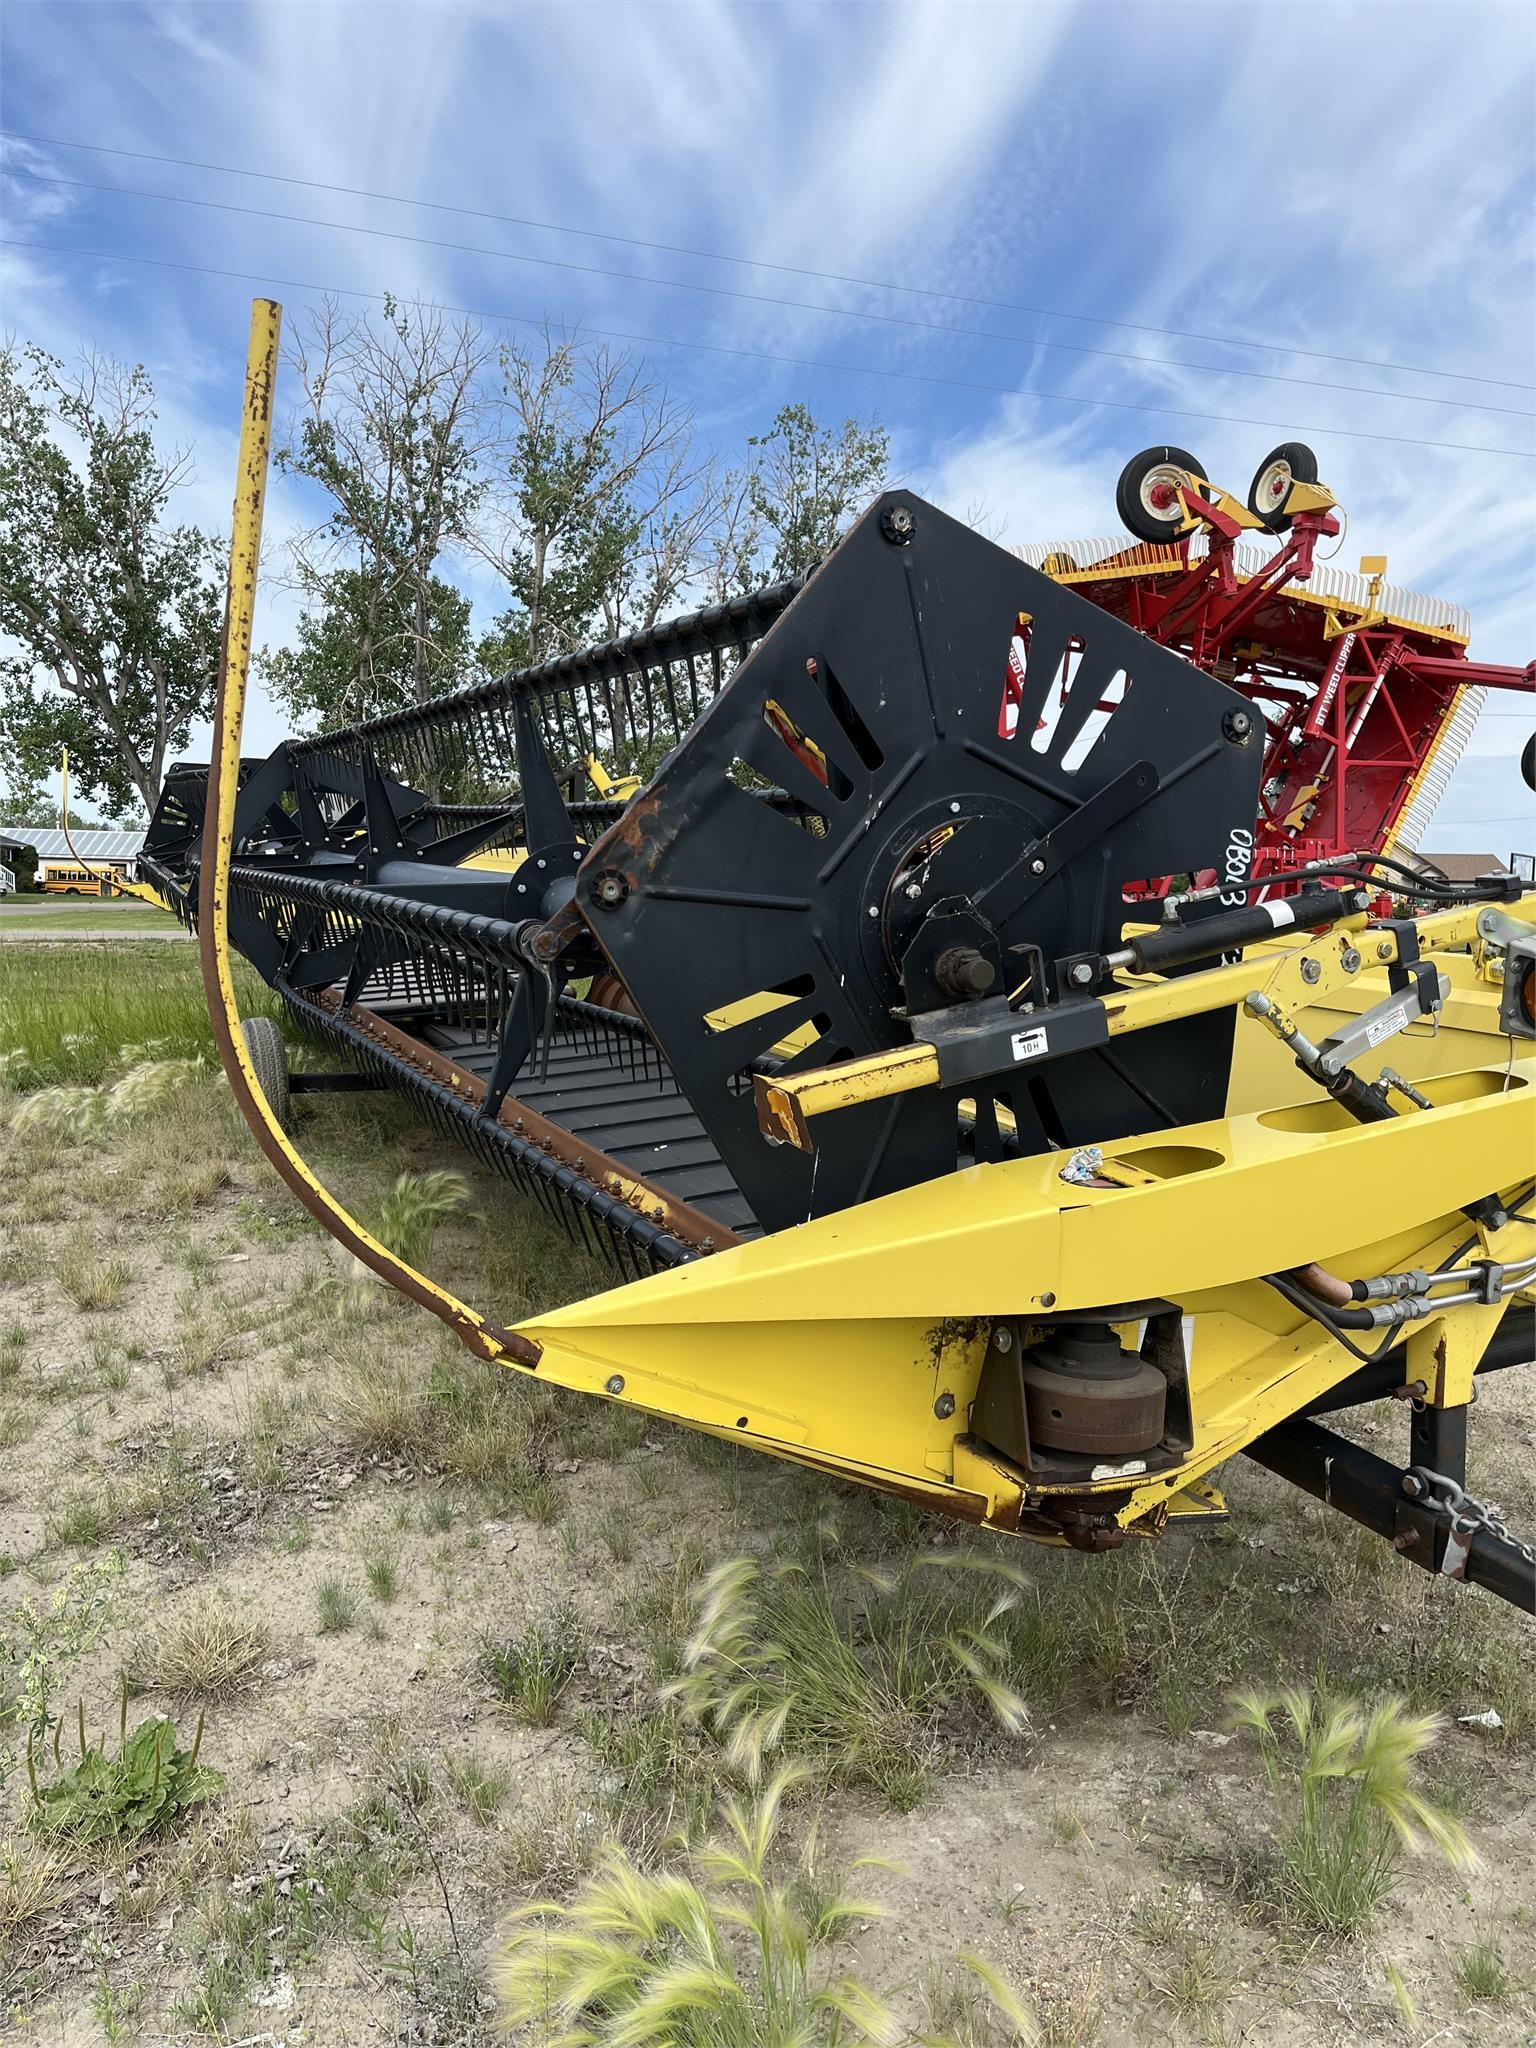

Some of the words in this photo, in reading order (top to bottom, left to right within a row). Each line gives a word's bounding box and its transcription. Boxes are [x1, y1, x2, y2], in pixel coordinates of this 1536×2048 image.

[1008, 647, 1023, 676] EED
[1315, 705, 1329, 727] BTT
[1322, 674, 1341, 705] WEED
[1335, 632, 1357, 674] CLIPPER
